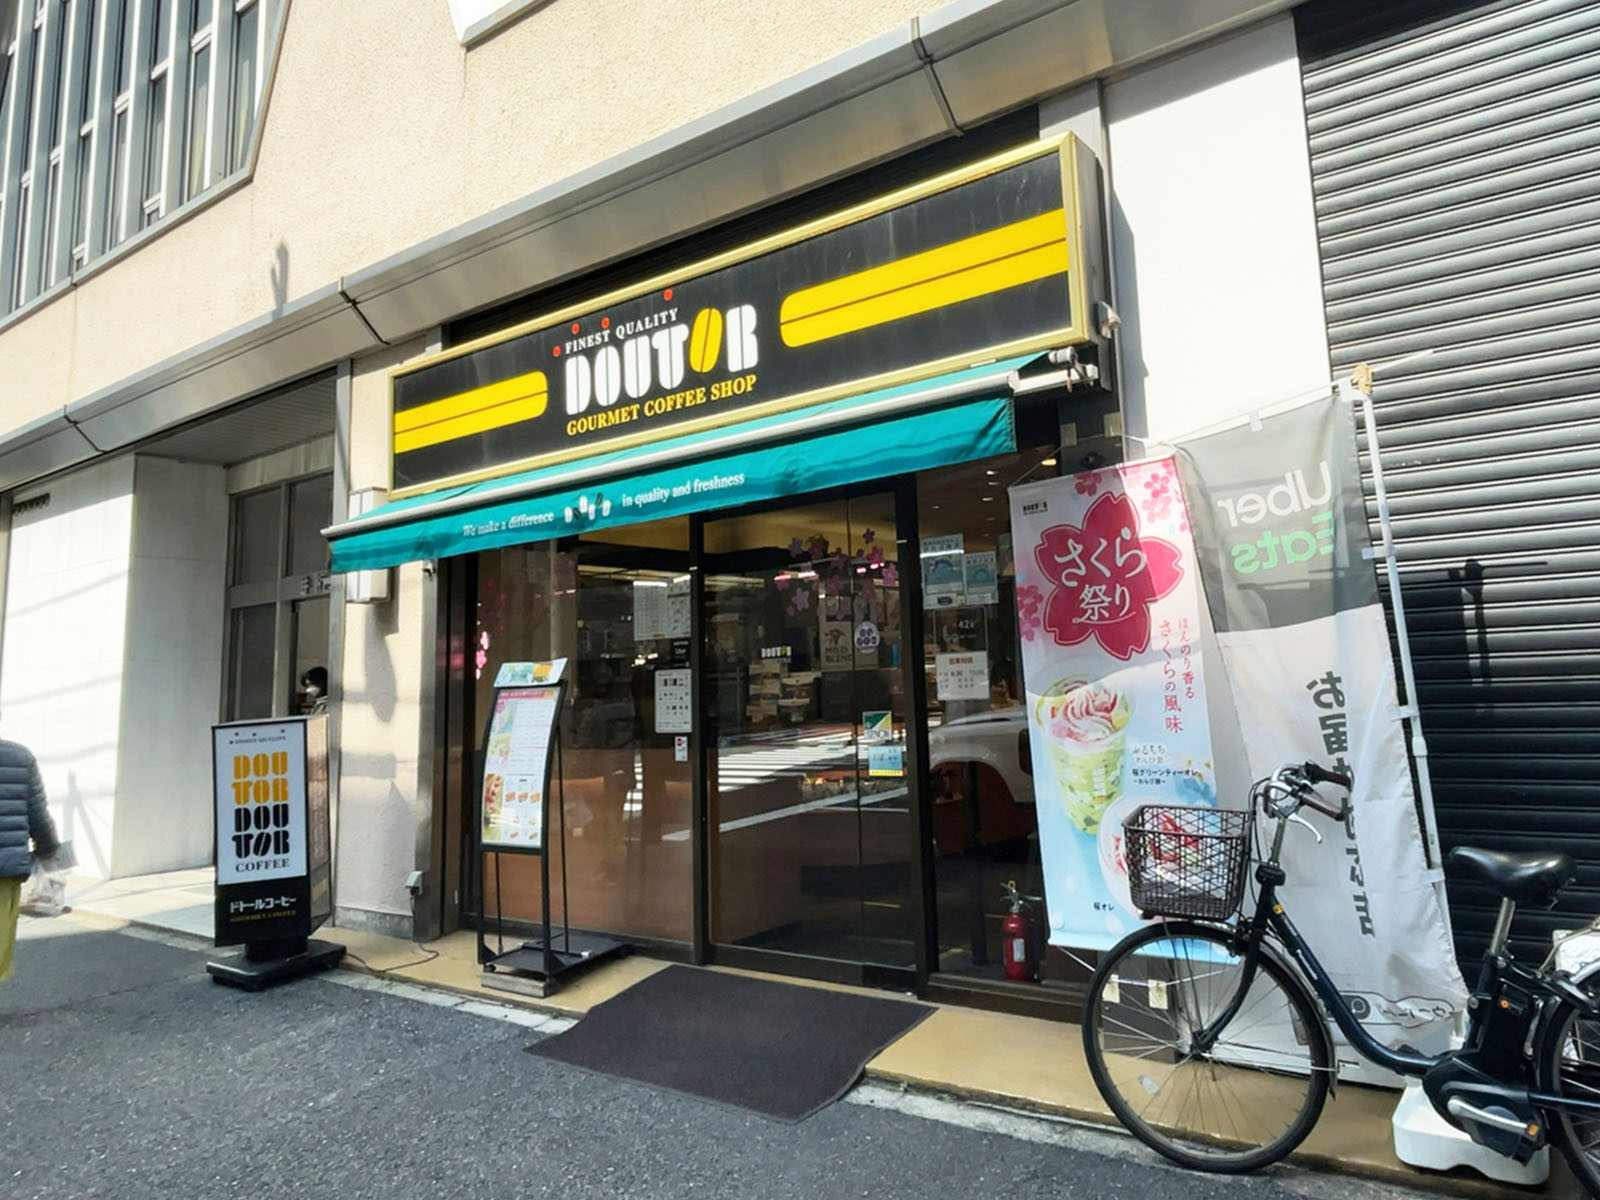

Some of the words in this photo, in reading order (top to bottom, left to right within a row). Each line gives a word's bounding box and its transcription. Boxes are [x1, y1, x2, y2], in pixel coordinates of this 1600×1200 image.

[565, 329, 610, 354] FINEST
[616, 308, 678, 339] QUALITY
[565, 304, 758, 416] DOUTOR
[567, 404, 640, 436] GOURMET
[644, 387, 706, 416] COFFEE
[711, 374, 757, 401] SHOP
[508, 512, 555, 529] difference
[622, 494, 633, 507] in
[634, 487, 670, 508] quality
[672, 481, 691, 498] and
[693, 473, 745, 493] freshness
[1054, 526, 1147, 588] さくら
[1078, 583, 1131, 622] 祭り
[1159, 619, 1184, 734] さくらの風味
[1178, 618, 1195, 699] ほんのり香る
[233, 751, 288, 780] DOU
[231, 778, 288, 806] TOR
[234, 803, 289, 833] DOU
[231, 829, 290, 859] TOR
[235, 858, 291, 873] COFFEE
[230, 896, 297, 914] ドトールコーヒー
